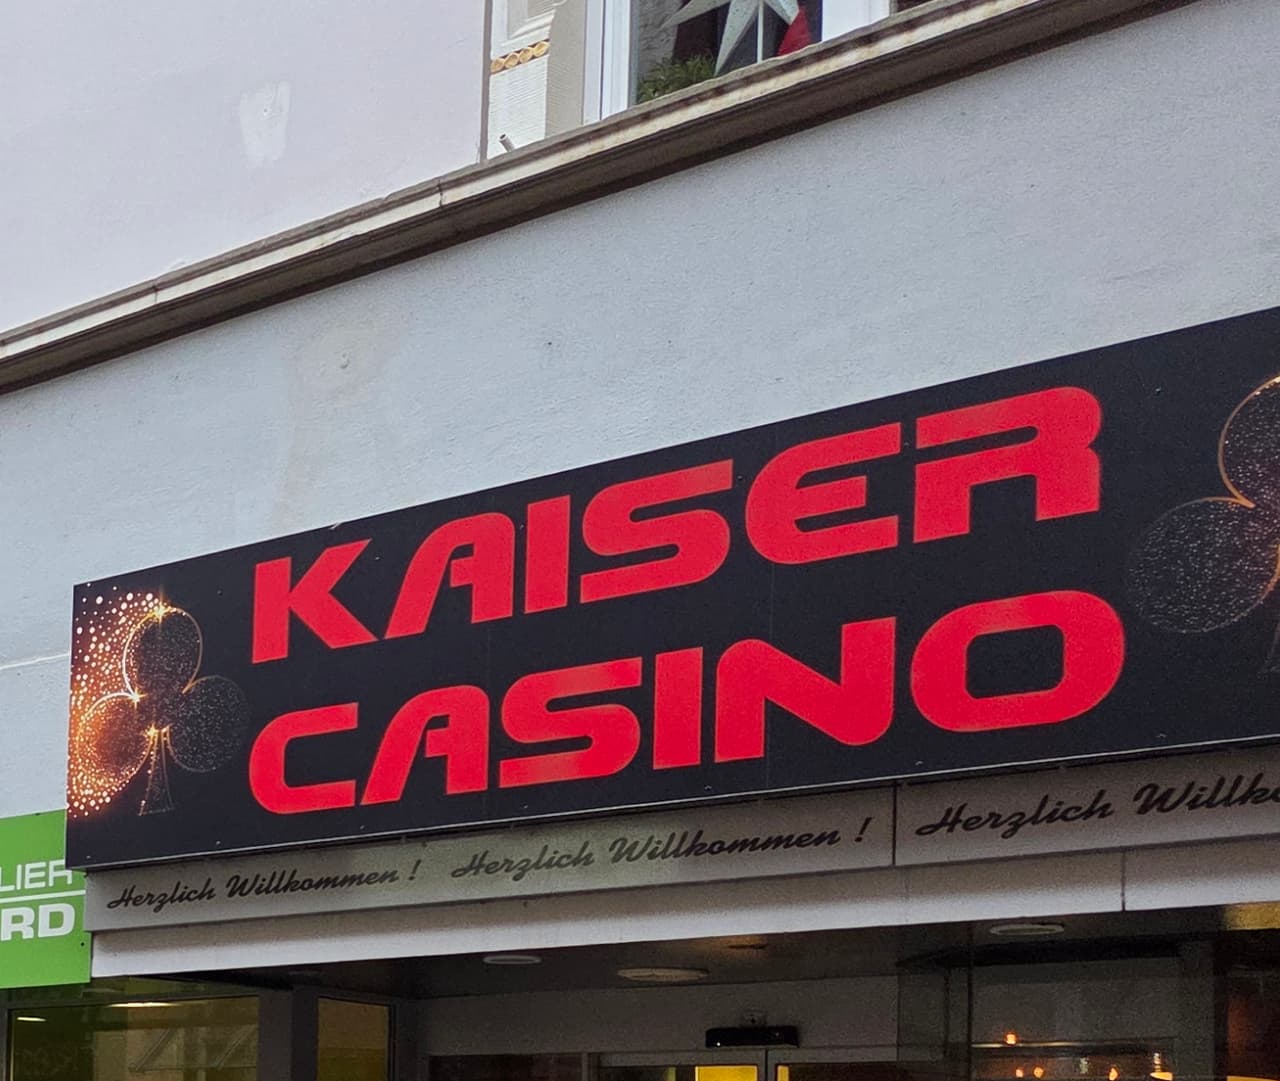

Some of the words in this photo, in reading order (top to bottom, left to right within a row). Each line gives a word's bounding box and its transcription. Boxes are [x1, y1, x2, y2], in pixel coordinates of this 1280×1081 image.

[252, 386, 1102, 664] KAISER
[248, 589, 1126, 815] CASINO
[915, 787, 1115, 839] Herzlich
[450, 841, 596, 882] Herzlich
[608, 829, 841, 864] Willkommen
[107, 881, 217, 913] Herzlich
[225, 868, 400, 899] Willkommen
